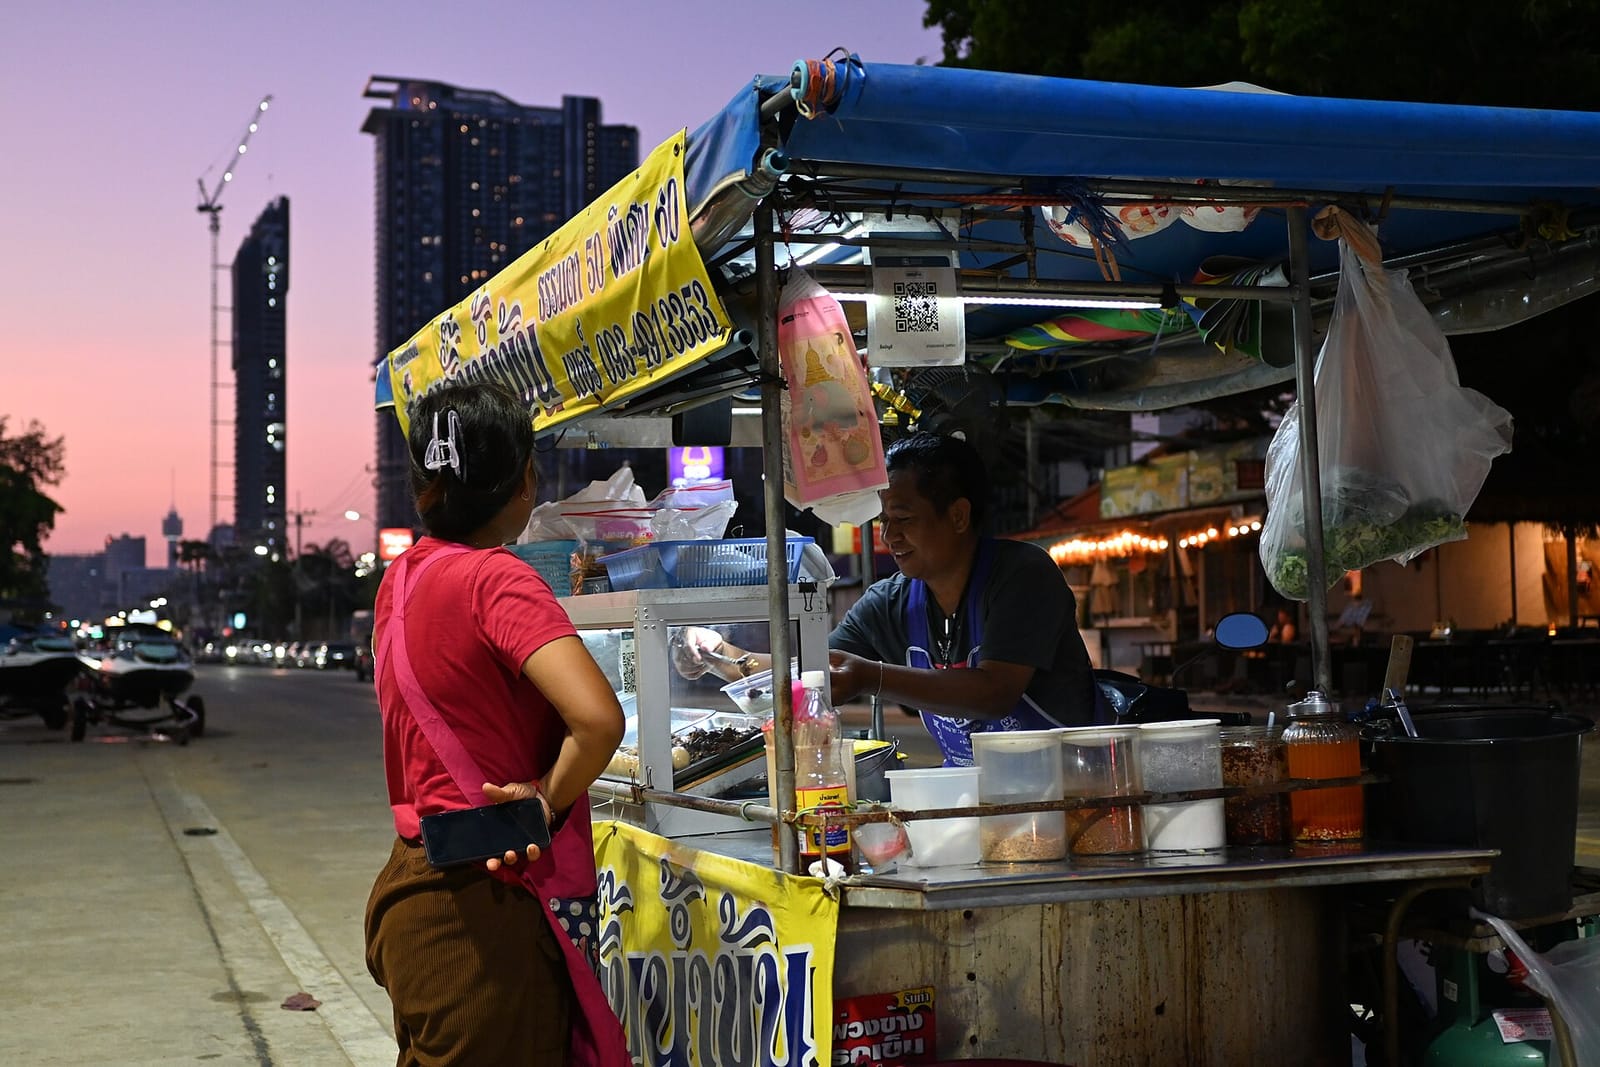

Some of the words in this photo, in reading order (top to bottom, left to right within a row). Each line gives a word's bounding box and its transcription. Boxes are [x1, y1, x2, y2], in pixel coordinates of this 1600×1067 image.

[537, 250, 584, 321] ธรรมดา
[585, 232, 605, 296] 50
[654, 178, 680, 250] 60
[597, 279, 719, 386] 093-4913353
